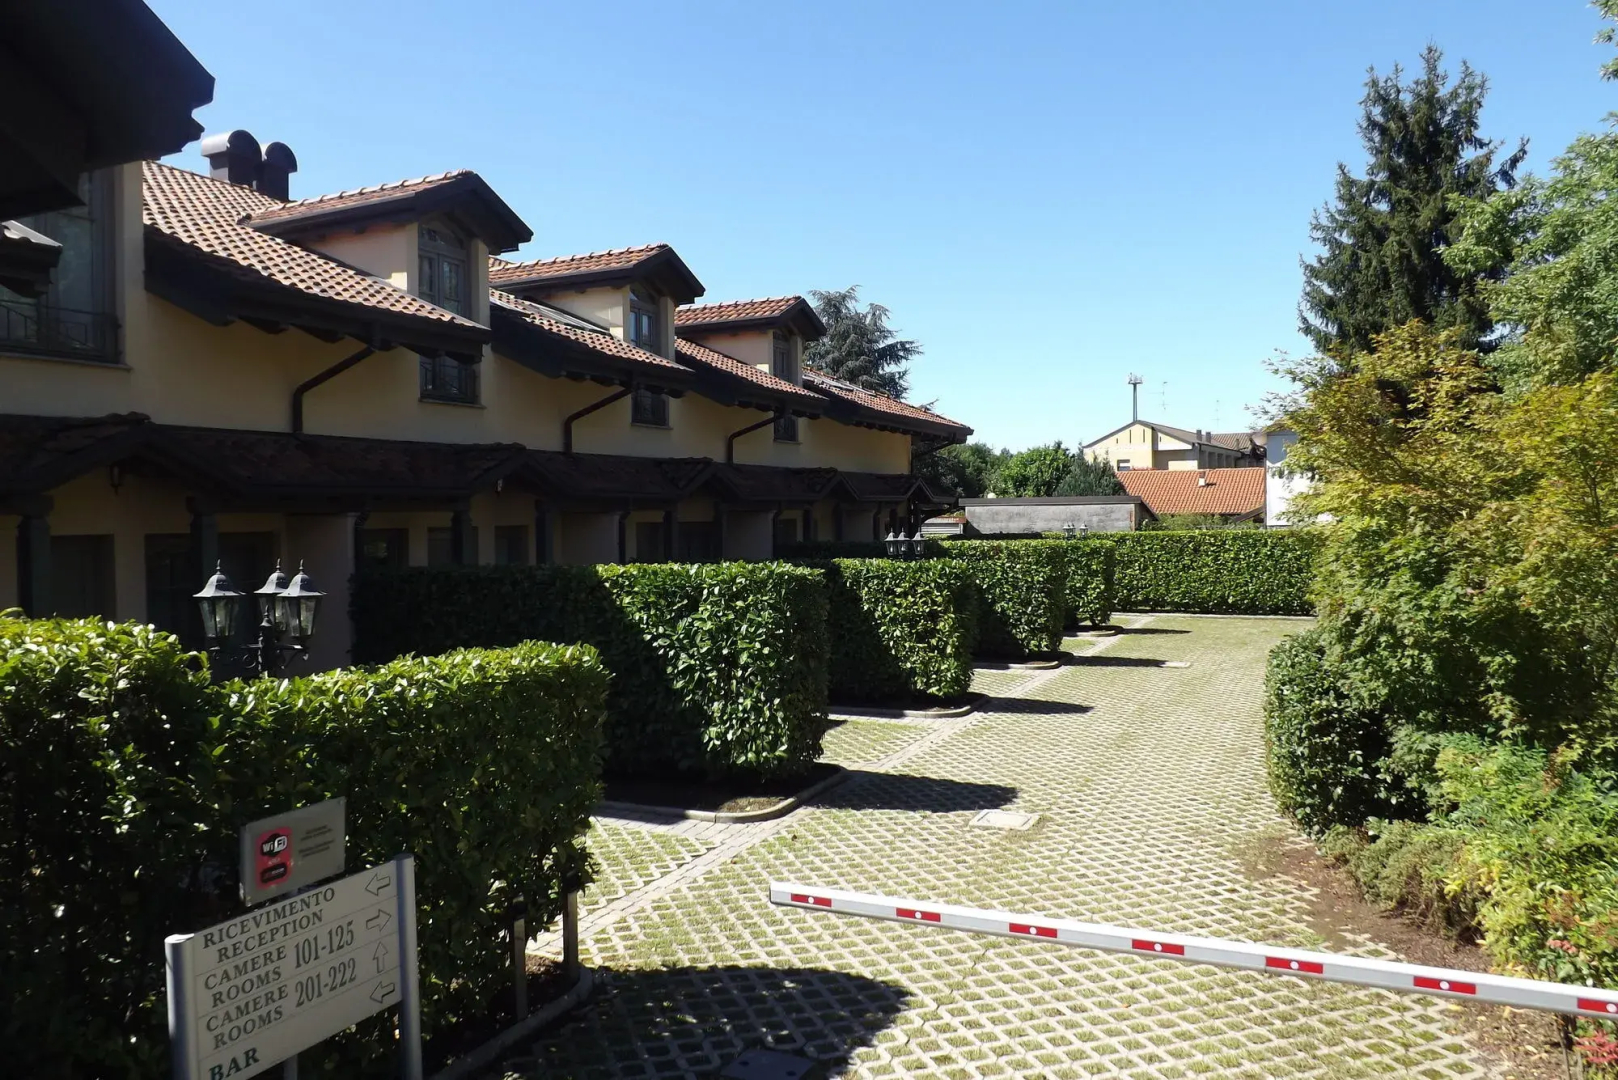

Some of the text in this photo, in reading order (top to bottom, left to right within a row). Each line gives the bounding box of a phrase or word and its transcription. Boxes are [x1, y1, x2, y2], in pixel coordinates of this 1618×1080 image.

[262, 836, 288, 853] WiFi
[202, 887, 336, 949] RICEVIMENTO
[216, 909, 324, 964] RECEPTION
[204, 945, 287, 990] CAMERE
[294, 920, 355, 969] 101-125
[211, 966, 282, 1008] ROOMS
[295, 957, 357, 1008] 201-222
[206, 984, 289, 1032] CAMERE
[213, 1005, 283, 1050] ROOMS
[208, 1047, 260, 1080] BAR
